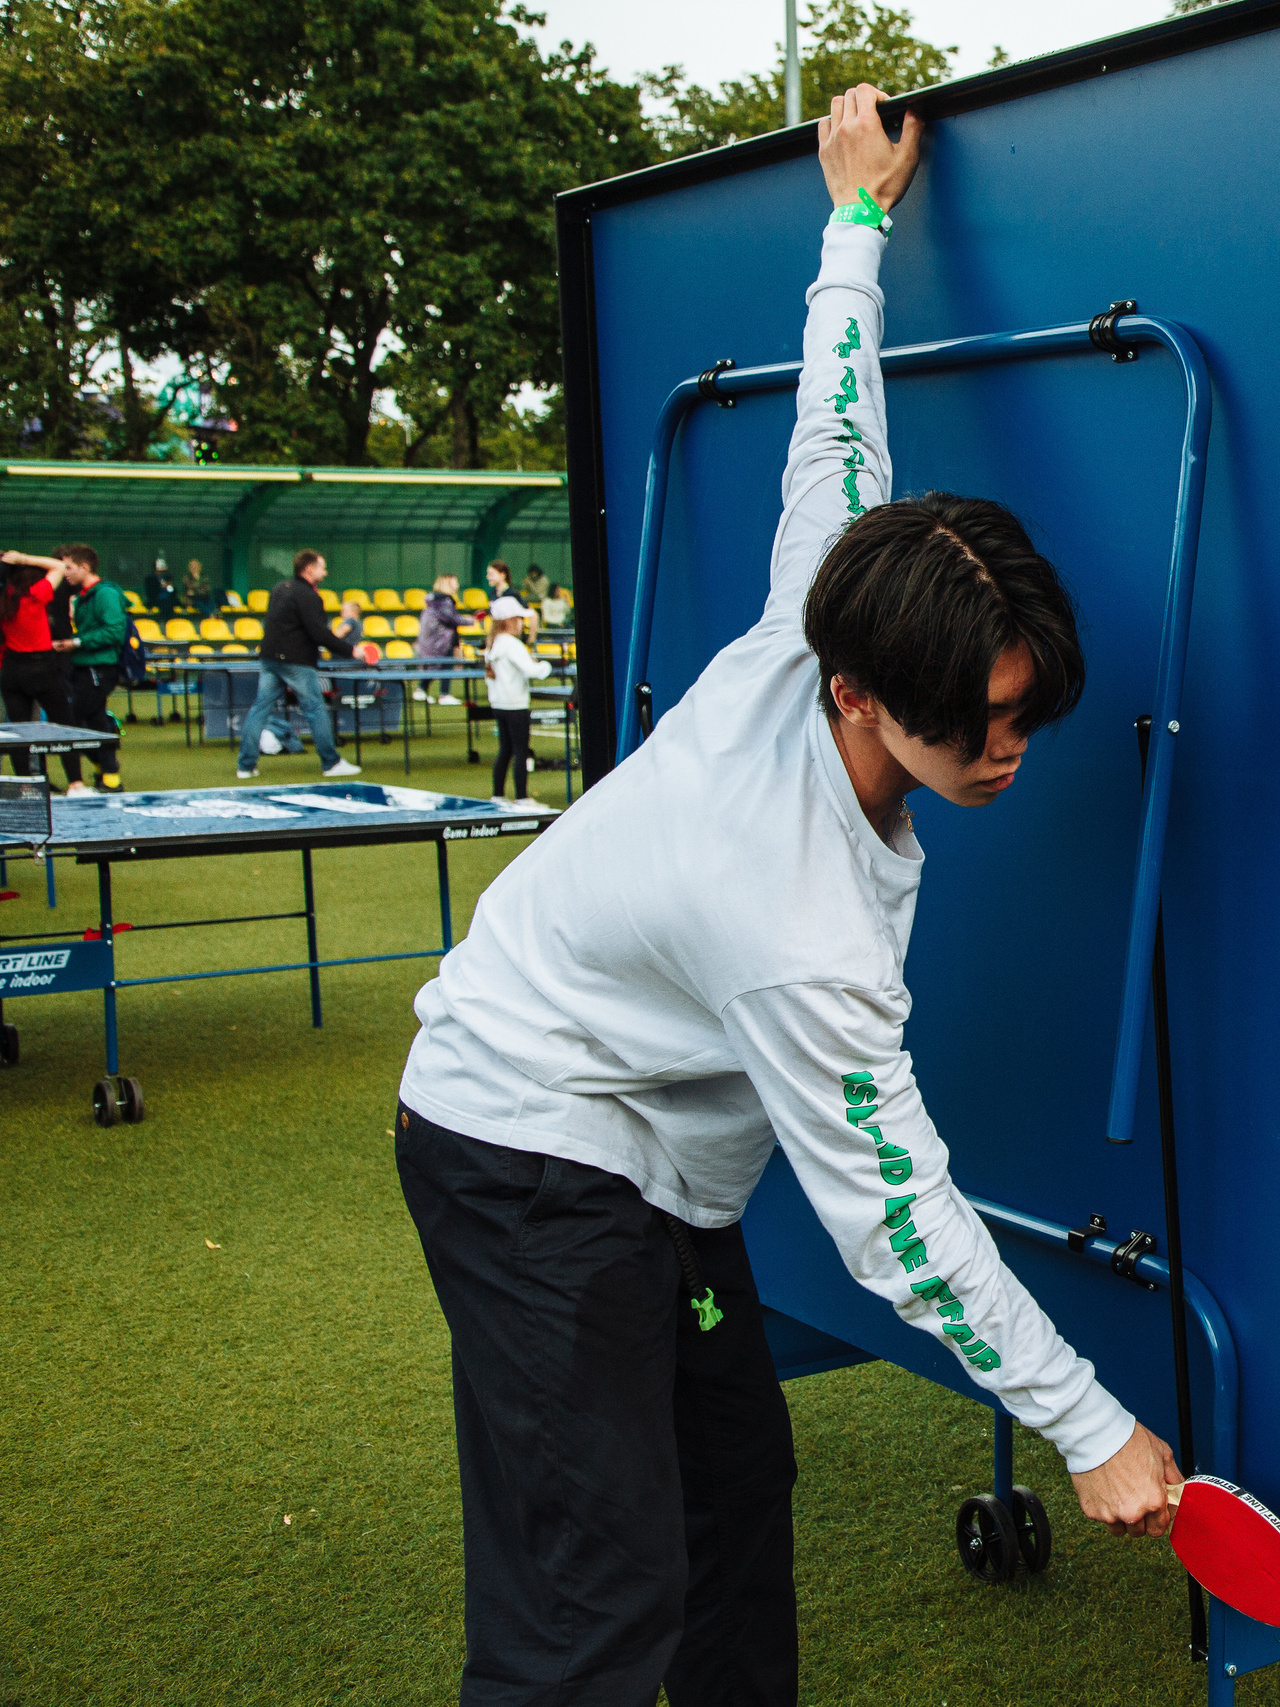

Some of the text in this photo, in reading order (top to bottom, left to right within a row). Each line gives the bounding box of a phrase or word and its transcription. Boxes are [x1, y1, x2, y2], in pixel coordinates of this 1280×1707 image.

[27, 953, 65, 967] LINE
[9, 971, 56, 989] indoor
[910, 1275, 1001, 1373] AFFAIR
[1204, 1476, 1237, 1492] START
[1242, 1494, 1266, 1513] LINE
